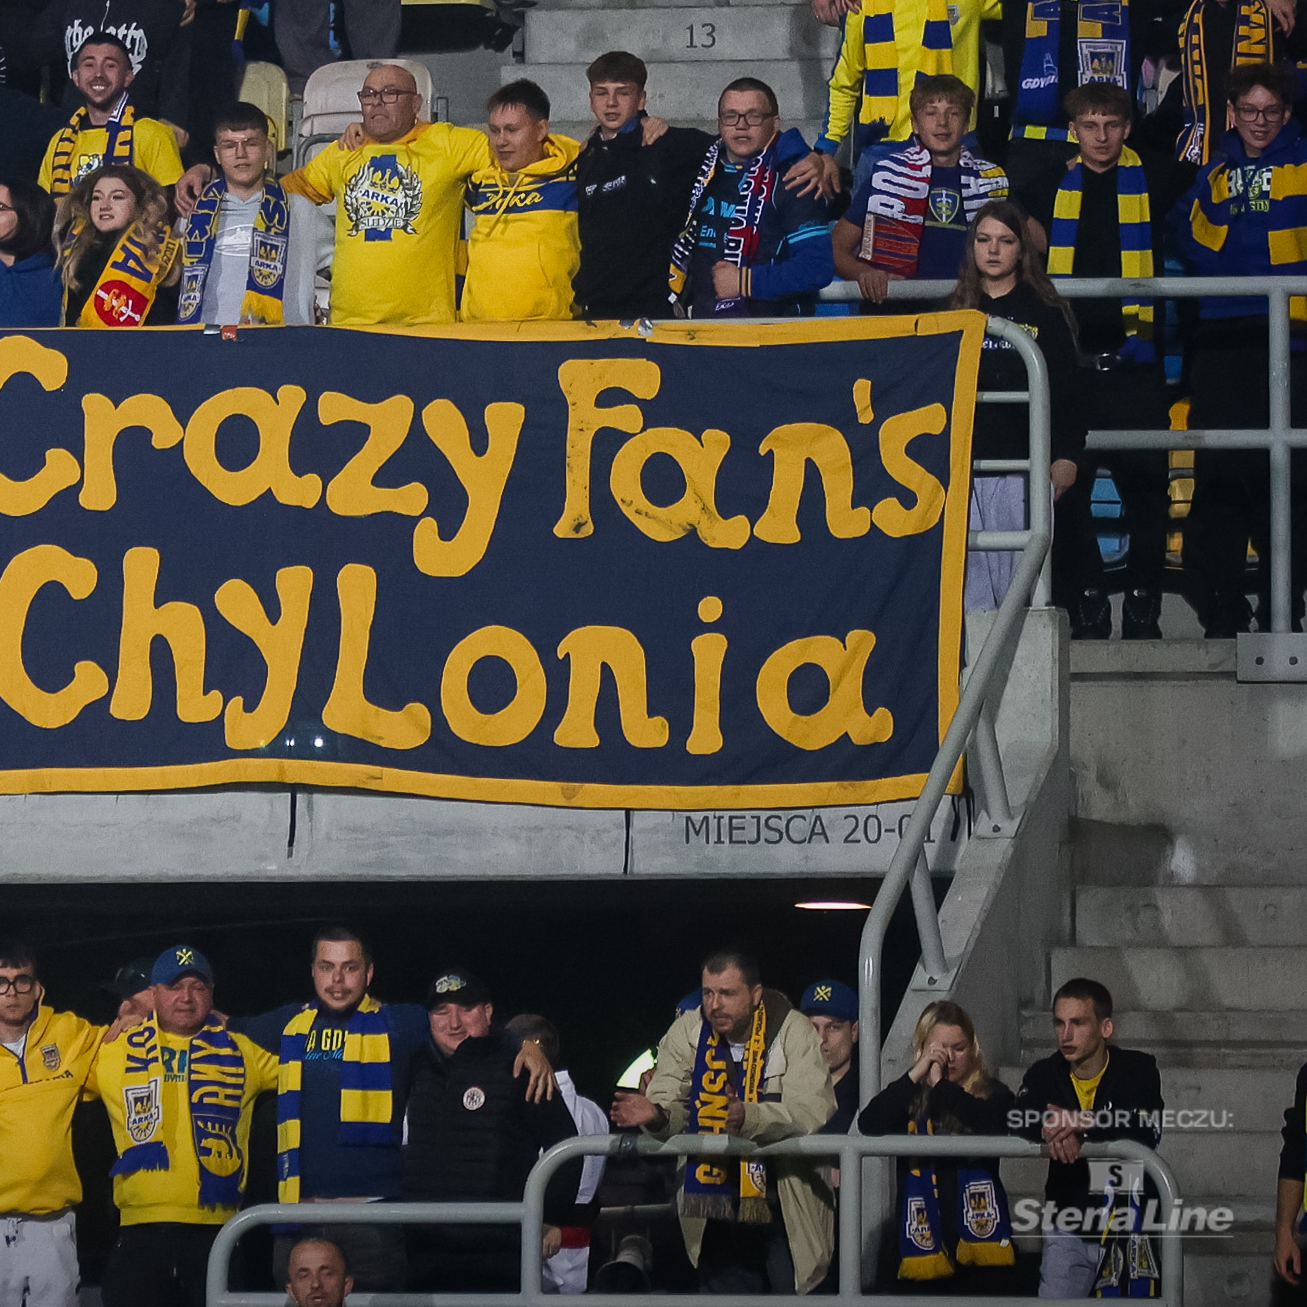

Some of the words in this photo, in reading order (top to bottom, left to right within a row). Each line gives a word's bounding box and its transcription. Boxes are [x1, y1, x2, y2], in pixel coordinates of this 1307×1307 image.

[686, 24, 716, 47] 13
[363, 189, 400, 207] ARKA
[487, 191, 543, 212] Arka
[255, 260, 282, 272] ARKA
[554, 358, 946, 549] Fan's
[685, 815, 829, 846] MIEJSCA
[130, 1112, 158, 1127] ARKA
[968, 1210, 995, 1222] ARKA
